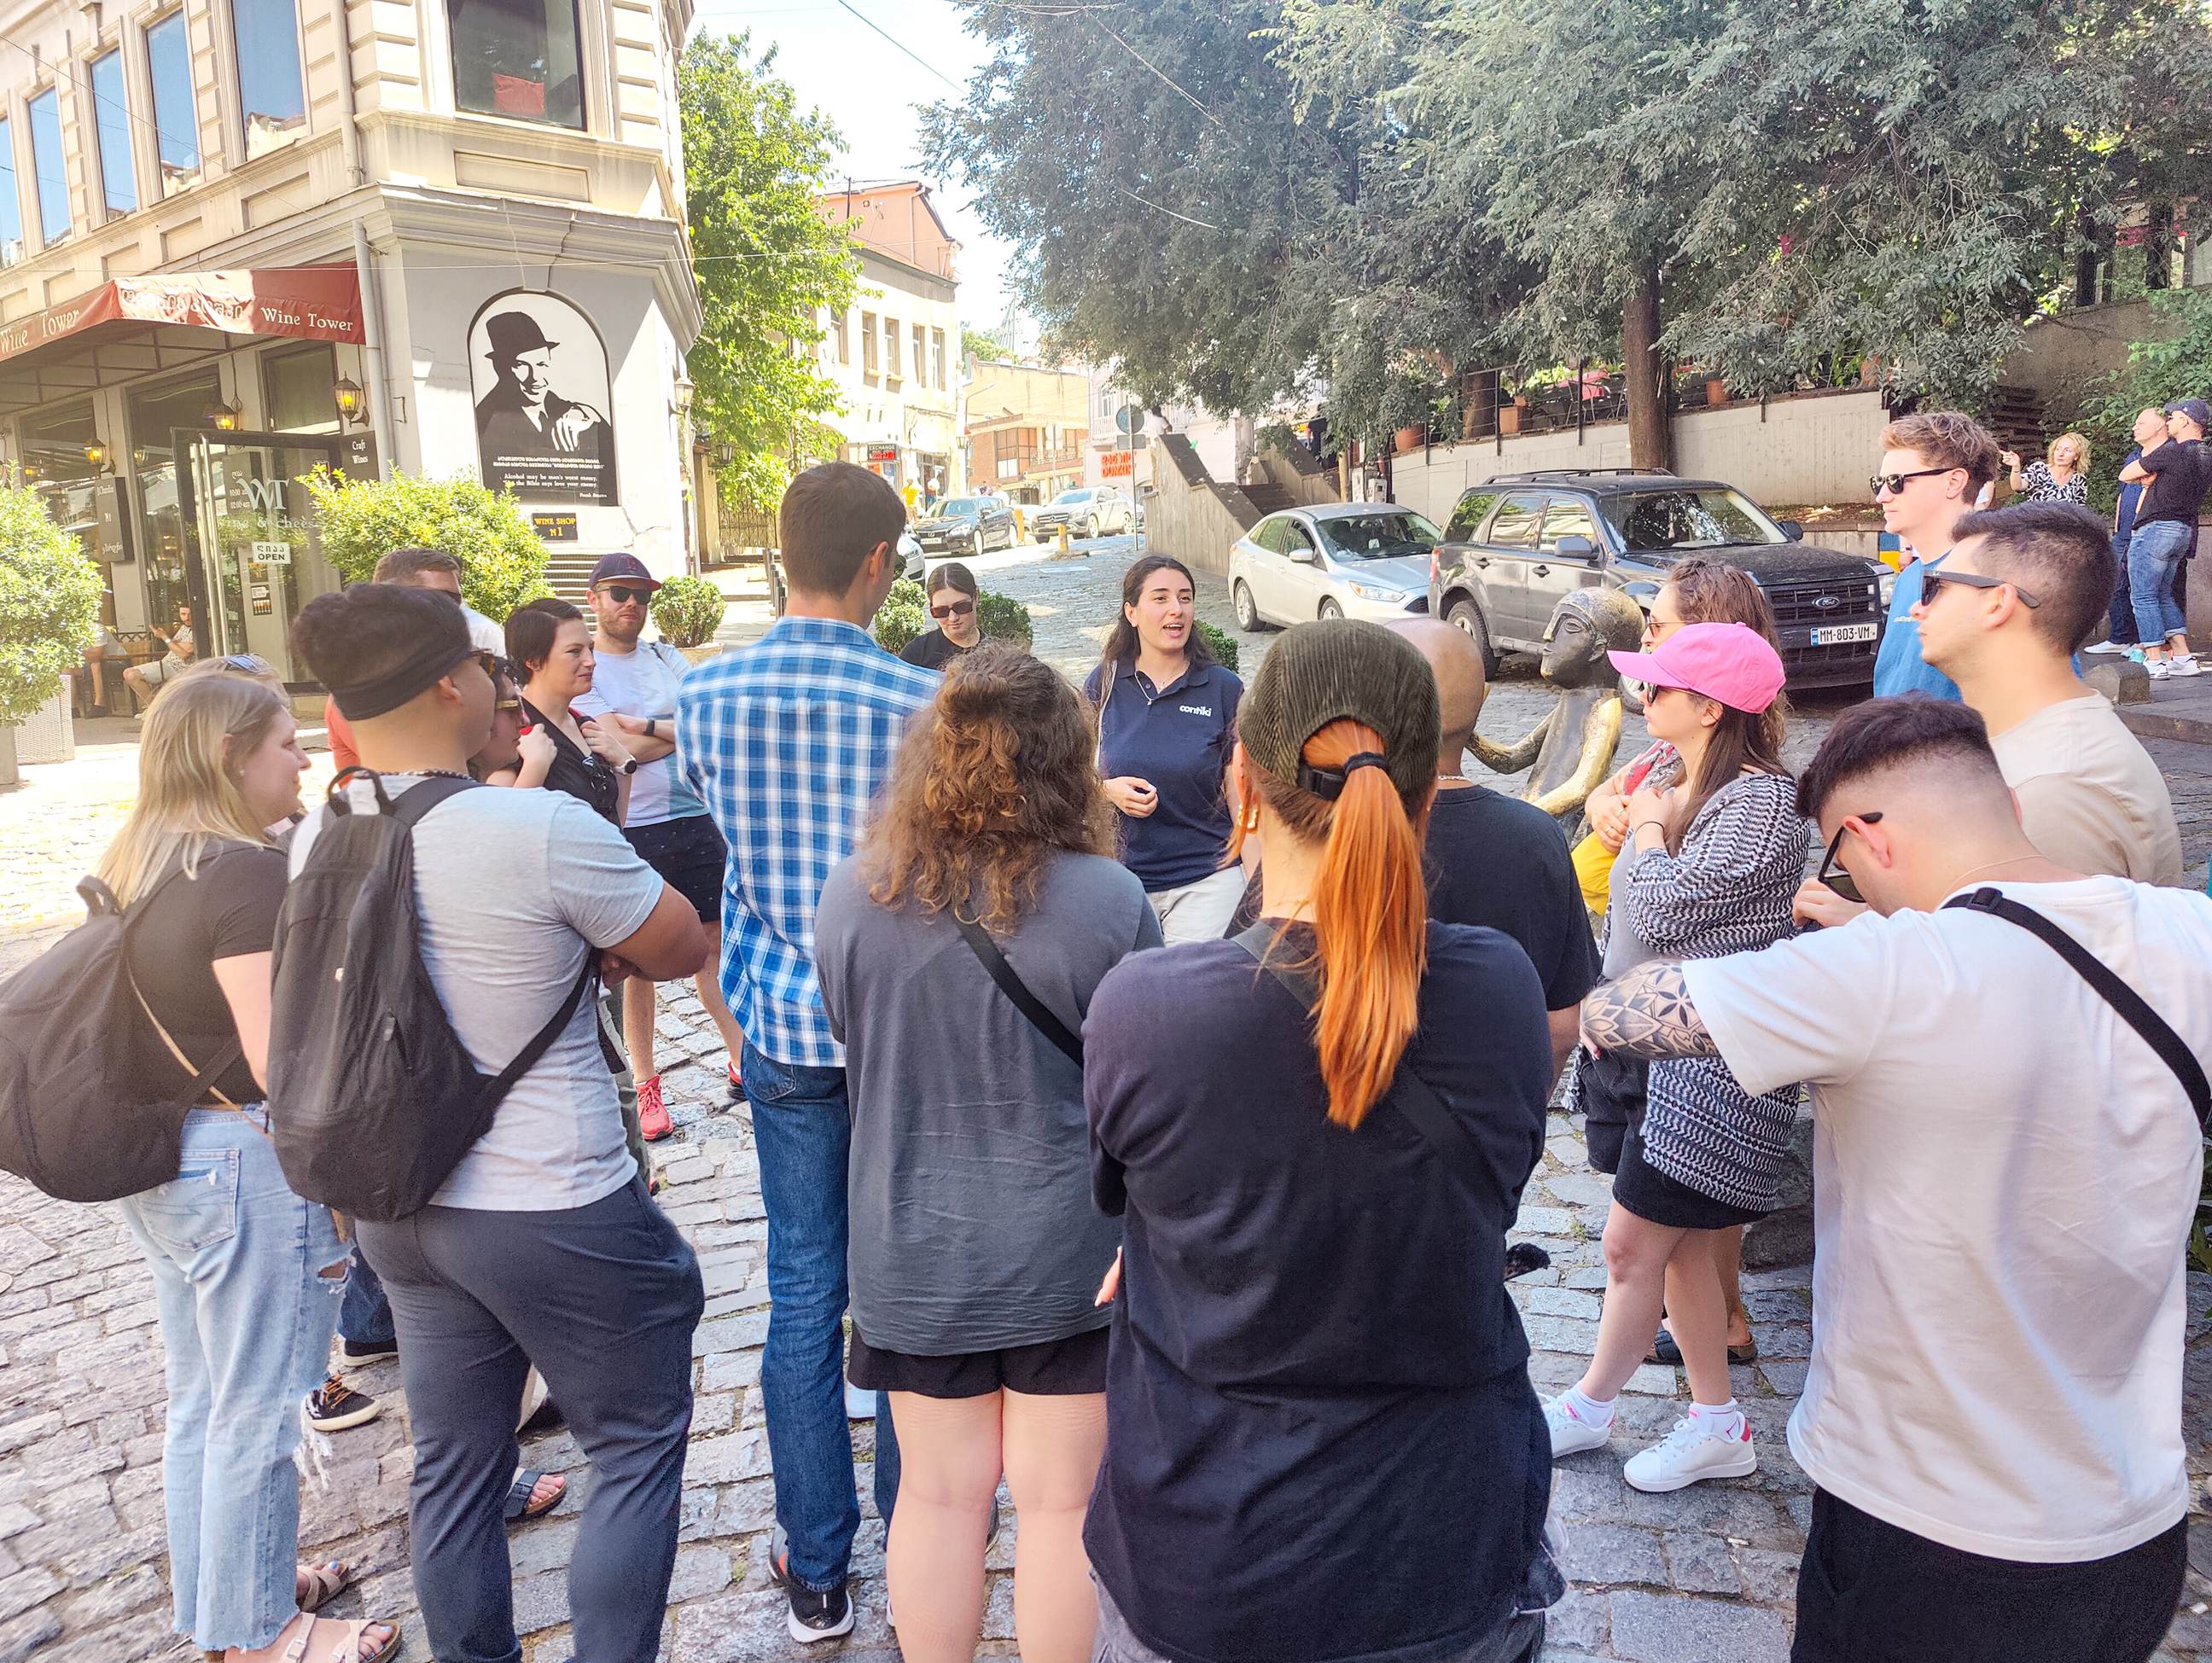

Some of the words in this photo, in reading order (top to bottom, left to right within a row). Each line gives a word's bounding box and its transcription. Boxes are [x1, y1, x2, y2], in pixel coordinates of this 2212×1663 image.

[260, 306, 300, 326] Wine
[307, 312, 353, 331] Tower
[0, 328, 29, 355] Wine
[39, 309, 80, 339] Tower
[352, 439, 366, 451] Craft
[352, 454, 369, 464] Wines
[526, 474, 538, 484] may
[533, 517, 555, 526] WINE
[556, 517, 576, 526] SHOP
[1819, 626, 1870, 643] MM-803-VM
[1179, 705, 1213, 718] contiki
